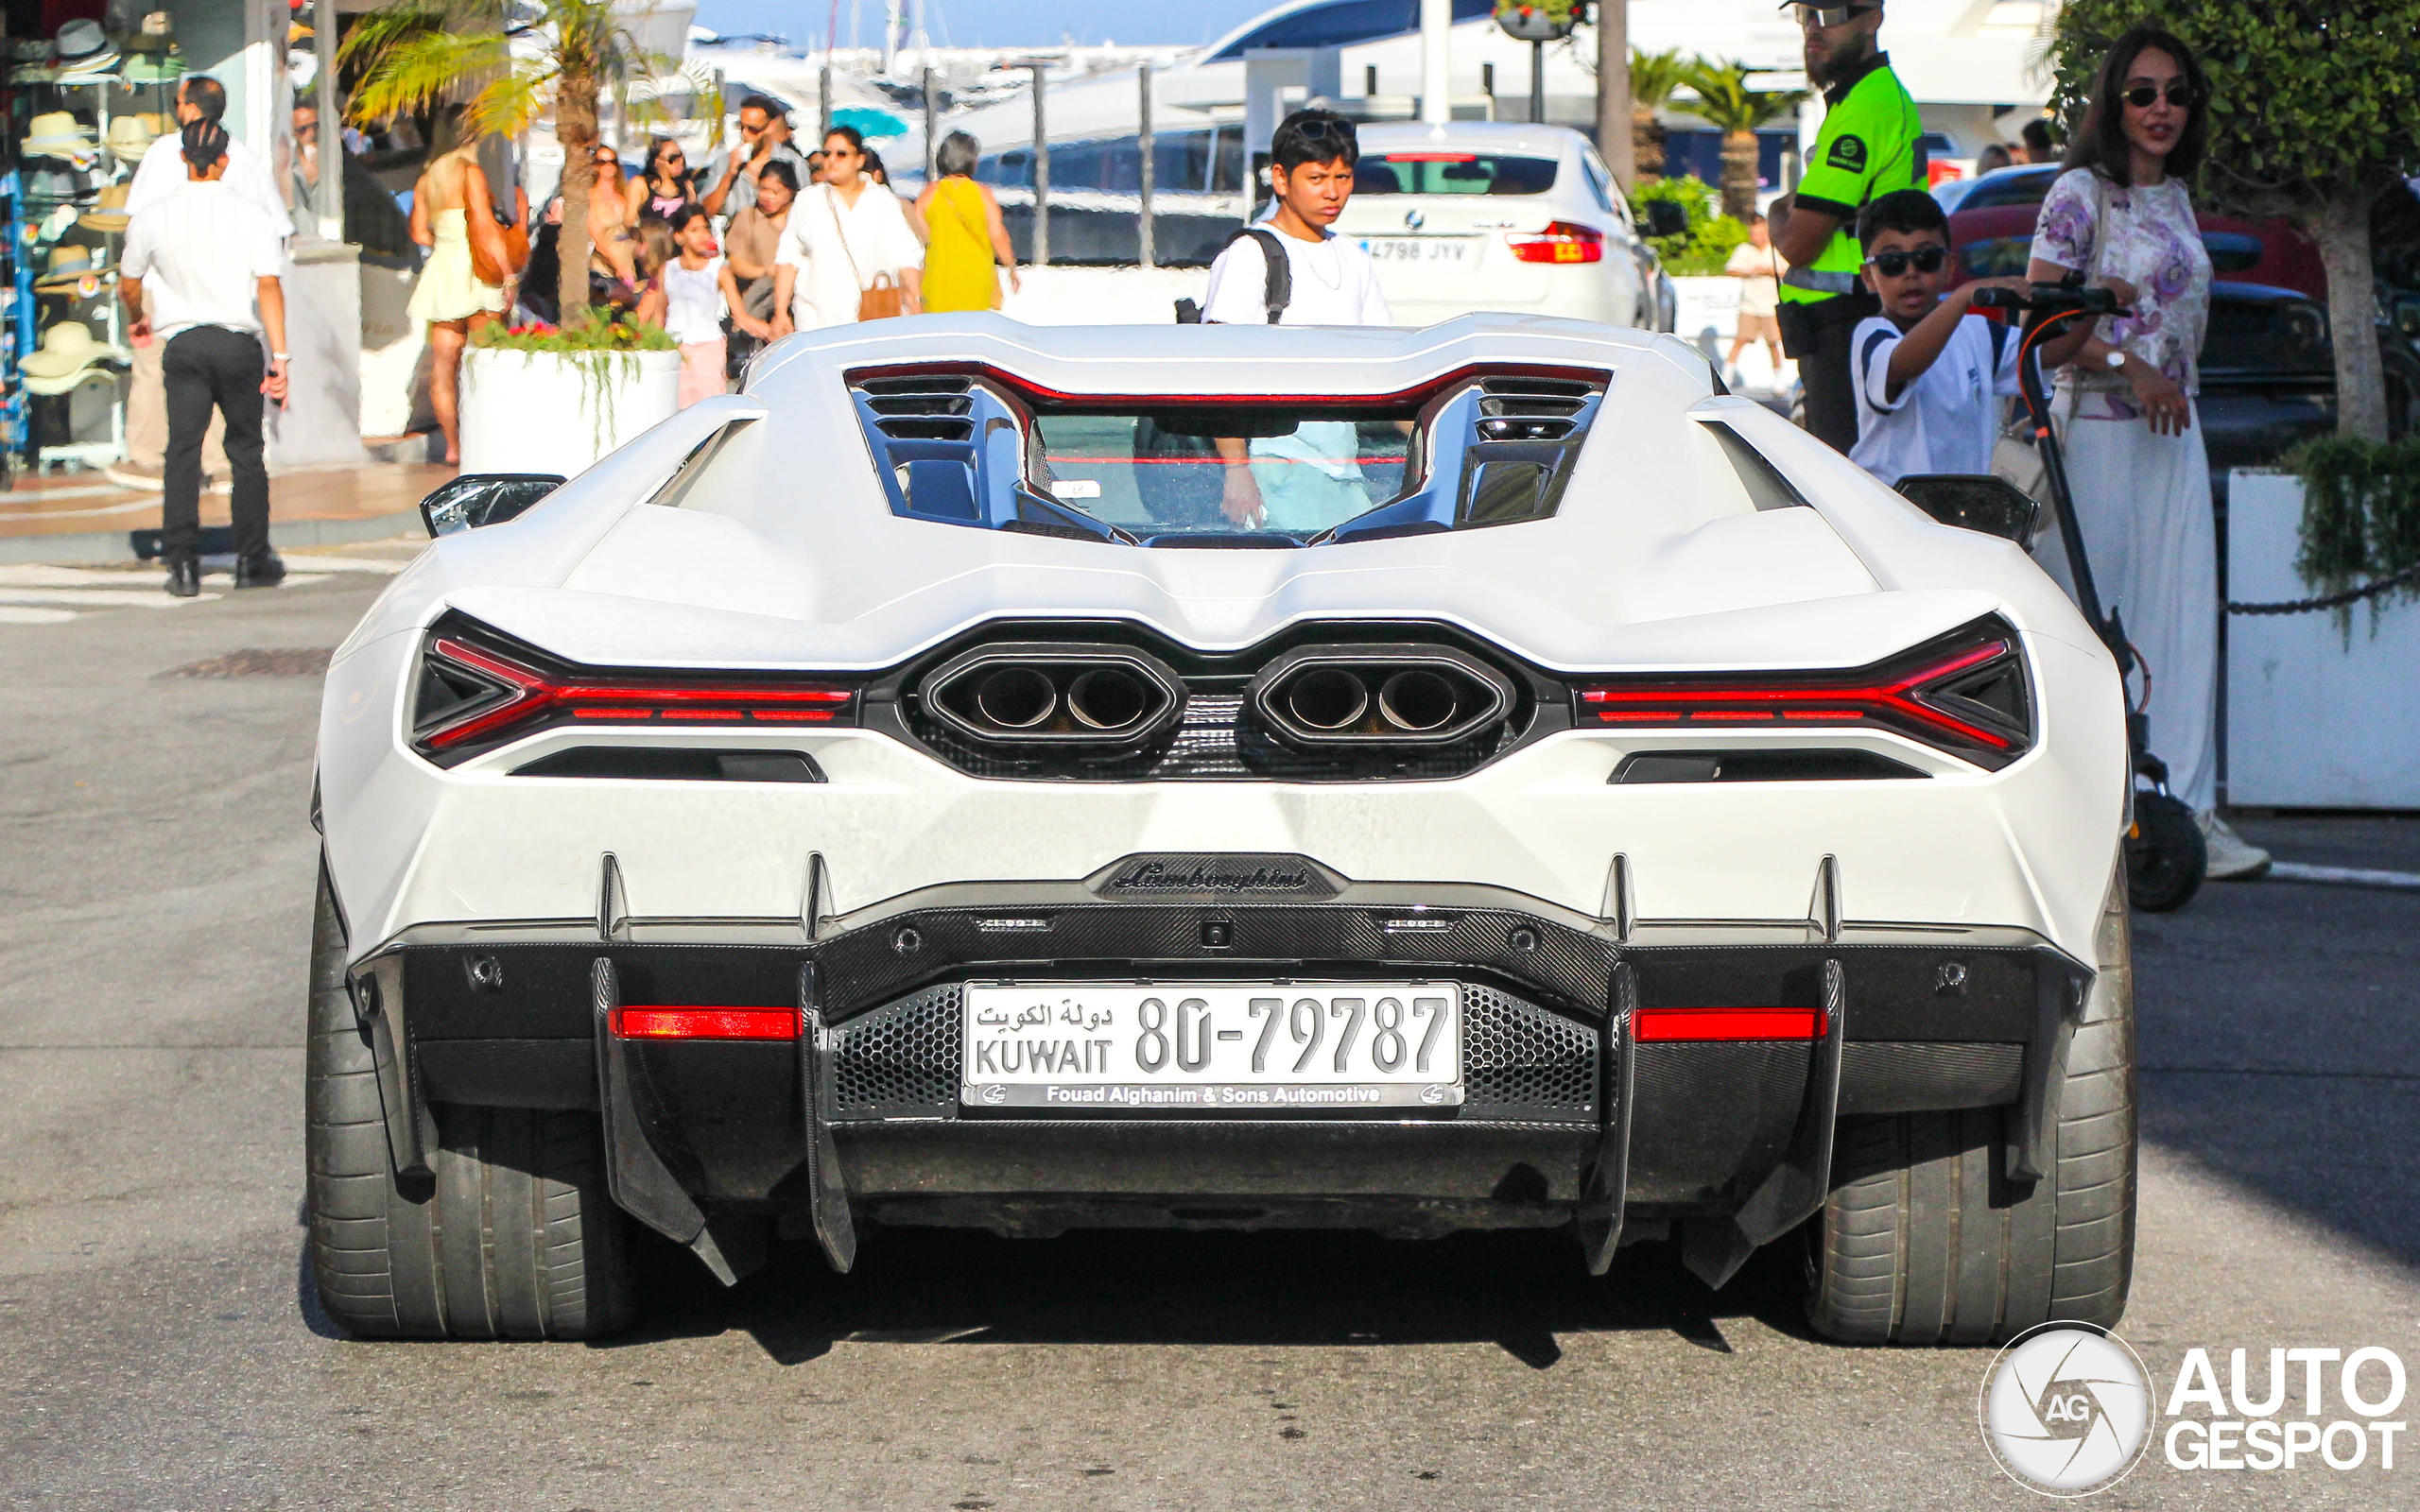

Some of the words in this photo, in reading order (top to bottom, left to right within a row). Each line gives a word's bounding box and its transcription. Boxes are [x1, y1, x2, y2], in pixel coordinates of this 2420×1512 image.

[1114, 862, 1308, 893] Lamborghini
[977, 1004, 1052, 1034] الكويت
[1061, 998, 1113, 1032] دولة
[1135, 997, 1448, 1074] 80-79787
[977, 1040, 1114, 1074] KUWAIT
[1046, 1086, 1105, 1103] Fouad
[1109, 1086, 1197, 1106] Alghanim
[1202, 1087, 1218, 1104] &
[1221, 1086, 1270, 1104] Sons
[1272, 1086, 1380, 1104] Automotive
